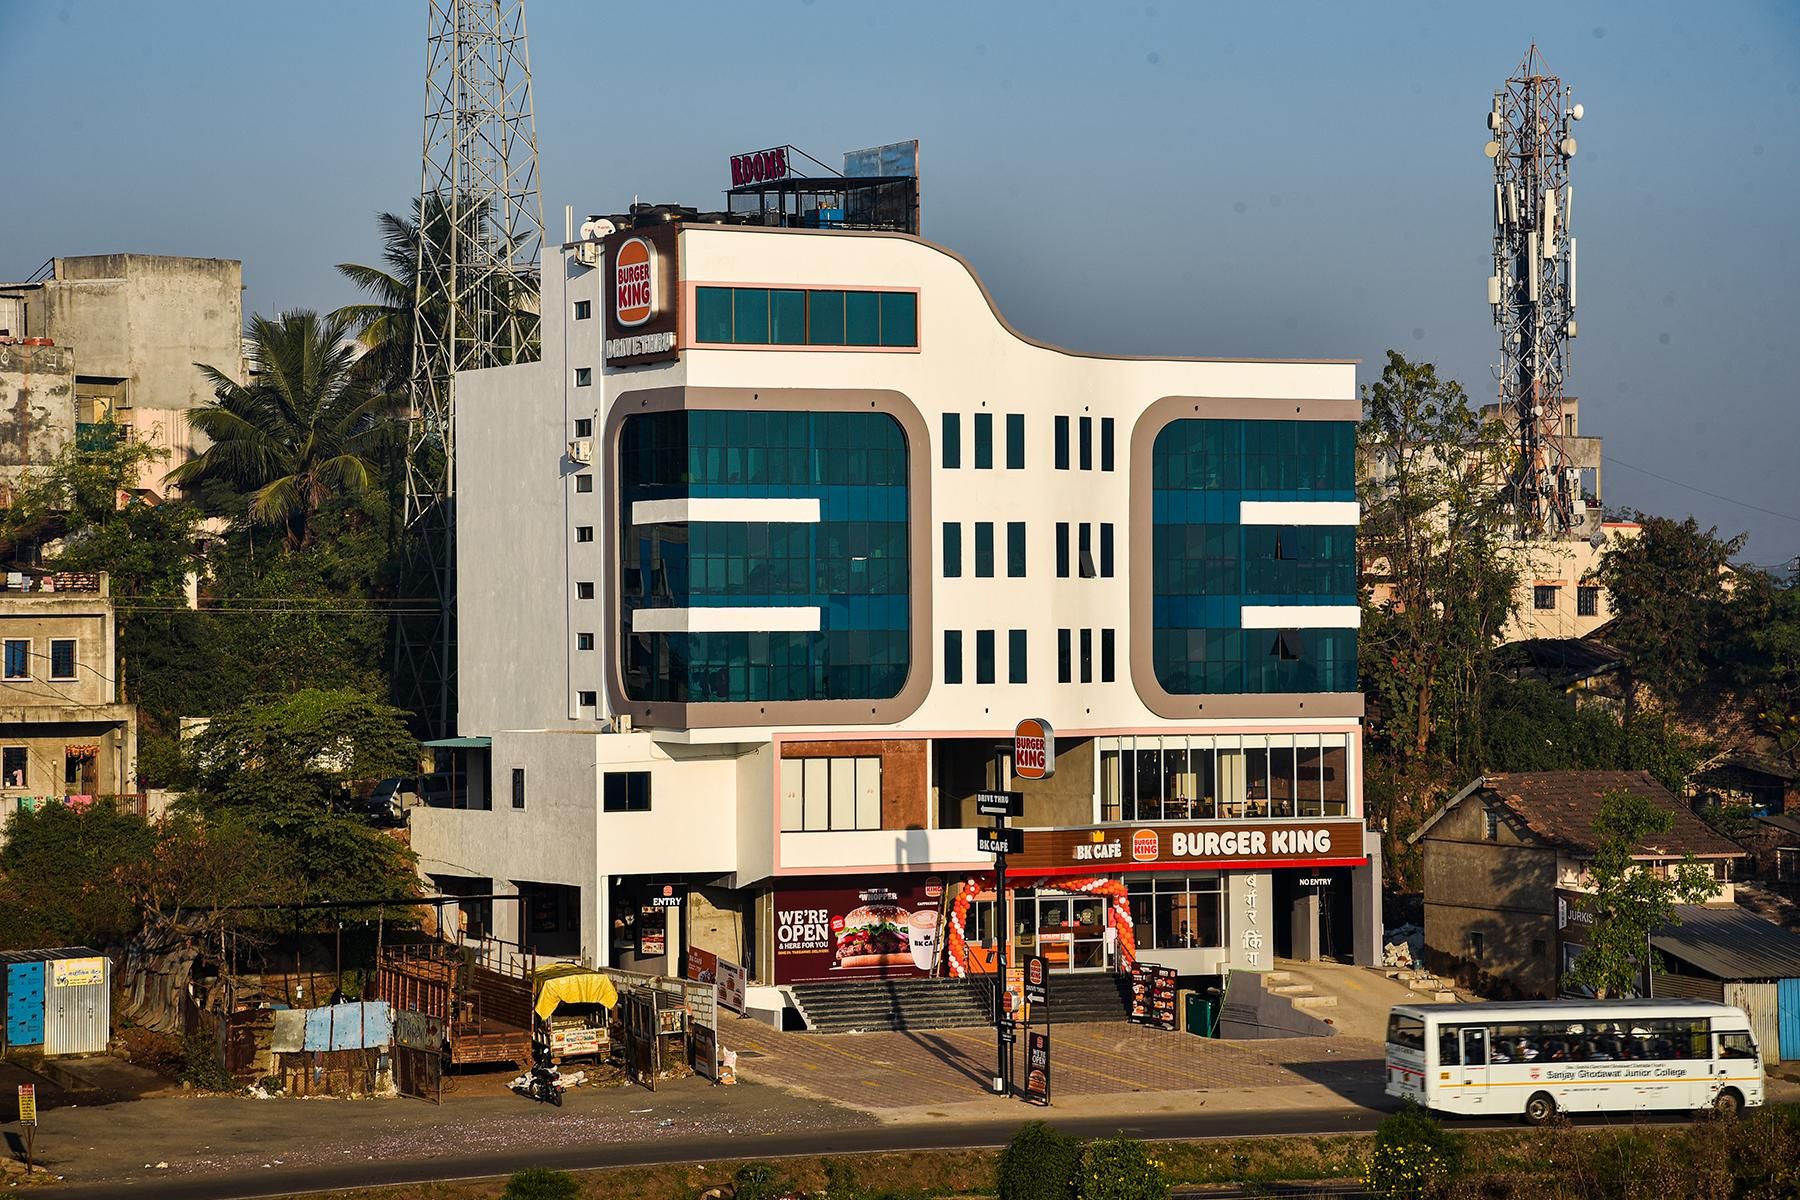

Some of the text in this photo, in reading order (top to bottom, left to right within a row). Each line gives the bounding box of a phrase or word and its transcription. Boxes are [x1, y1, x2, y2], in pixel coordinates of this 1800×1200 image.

[731, 148, 786, 186] ROOMS
[617, 263, 650, 285] BURGER
[618, 281, 650, 309] KING
[1016, 737, 1045, 751] BURGER
[1016, 749, 1045, 768] KING
[977, 793, 1009, 804] DRIVE THRU
[979, 839, 1009, 853] BK CAFÉ
[1075, 838, 1122, 860] BK CAFÉ
[1134, 838, 1157, 847] BURGER
[1172, 829, 1332, 857] BURGER KING
[1134, 845, 1158, 855] KING
[1299, 878, 1332, 886] NO ENTRY
[653, 897, 682, 906] ENTRY
[859, 892, 898, 902] WHOPPER
[777, 909, 829, 926] WE'RE
[777, 924, 829, 943] OPEN
[784, 942, 802, 950] HERE
[1031, 1055, 1046, 1065] OPEN
[1546, 1067, 1687, 1081] Sanjay Ghodawat Junior College
